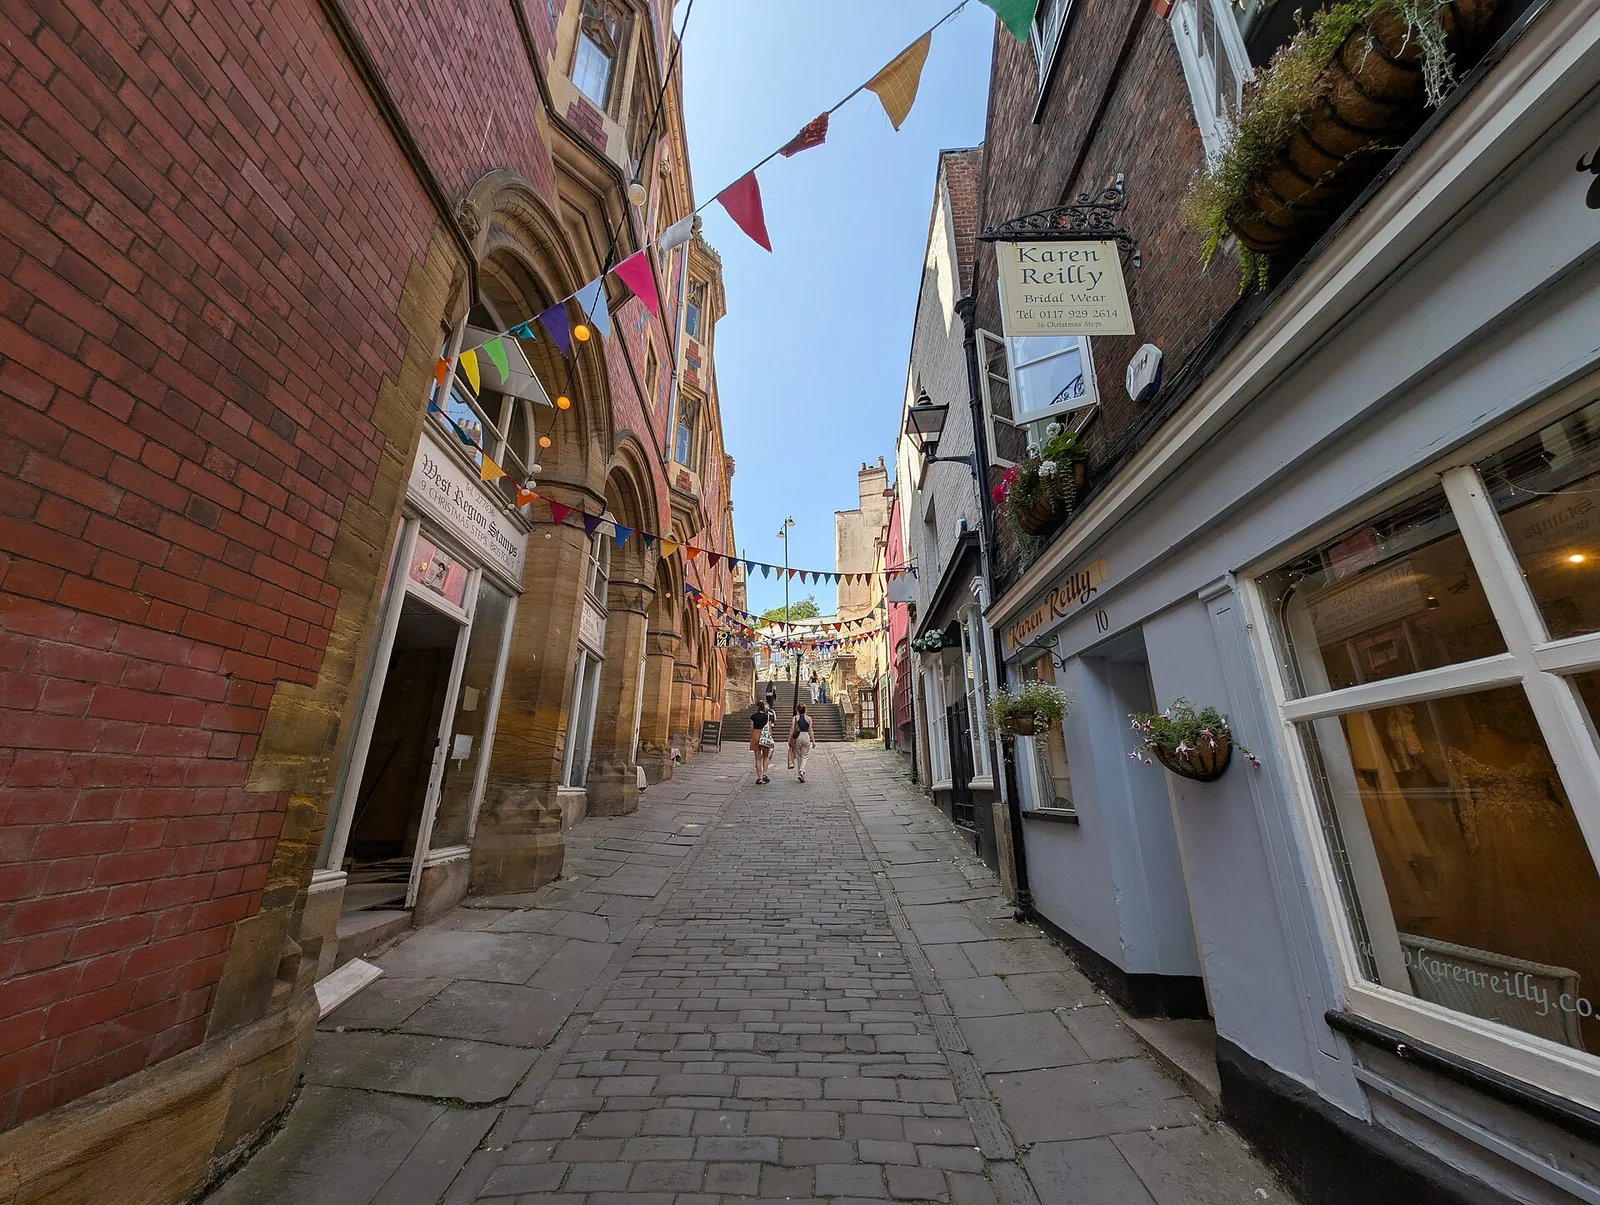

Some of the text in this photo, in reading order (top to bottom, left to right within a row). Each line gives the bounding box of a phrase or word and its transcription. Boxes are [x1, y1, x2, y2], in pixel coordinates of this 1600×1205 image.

[1017, 247, 1101, 263] Karen
[1020, 265, 1103, 291] Reilly
[1025, 292, 1106, 303] Bridal Wear
[1016, 309, 1118, 319] Tel: 0117 929 2614
[1046, 320, 1082, 329] Christmas
[1083, 320, 1103, 329] Steps
[421, 453, 518, 558] West Region Stamps
[420, 480, 427, 491] 9
[429, 487, 470, 529] CHRISTMAS
[489, 541, 510, 566] BRISTOL
[1009, 570, 1097, 649] Karen Reilly
